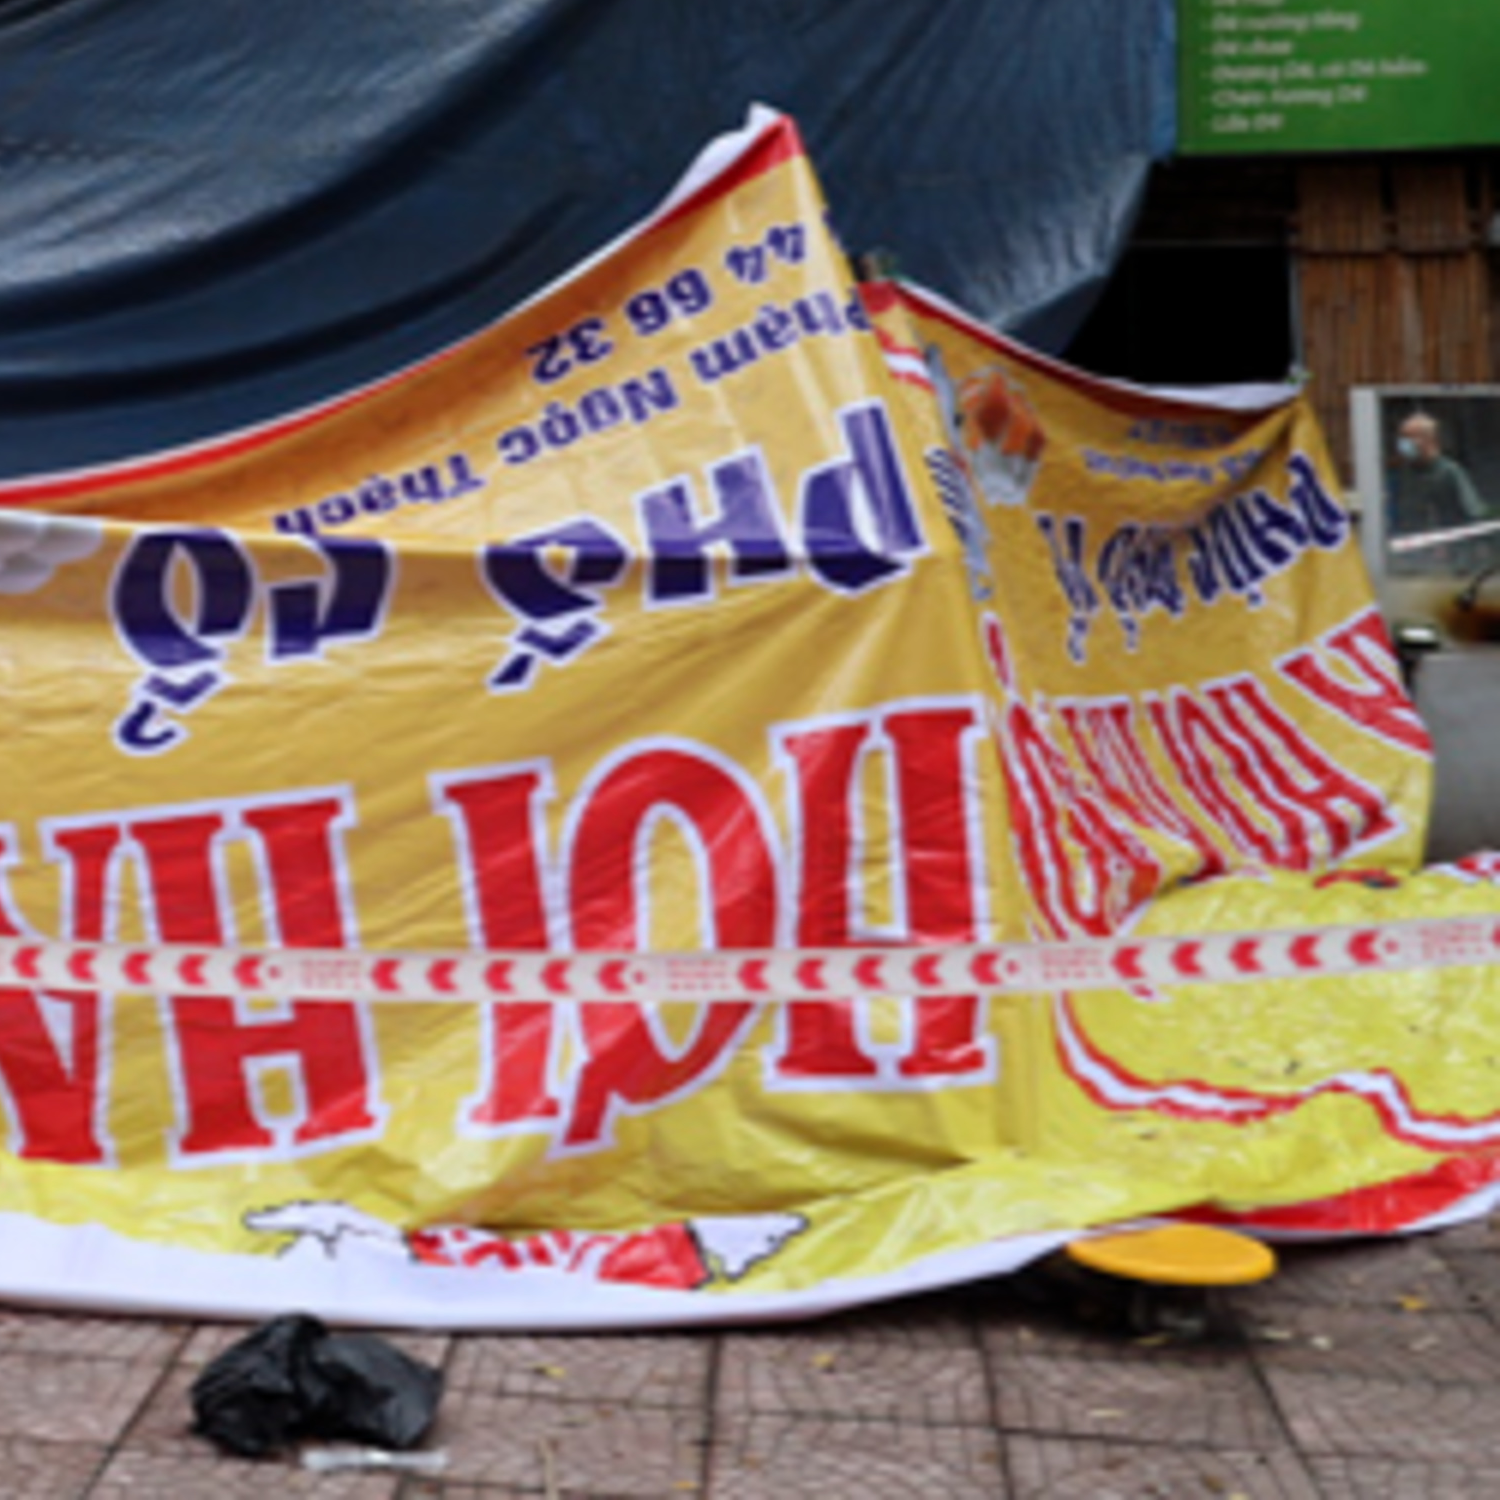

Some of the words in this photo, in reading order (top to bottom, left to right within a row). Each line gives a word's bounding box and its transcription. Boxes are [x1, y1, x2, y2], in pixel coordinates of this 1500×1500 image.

[525, 318, 615, 387] 32
[624, 268, 713, 338] 66
[496, 366, 681, 466] Ngọc
[273, 452, 487, 537] Thạch
[481, 400, 928, 690] PHỐ
[108, 520, 393, 752] CỔ
[430, 696, 995, 1155] HƠI
